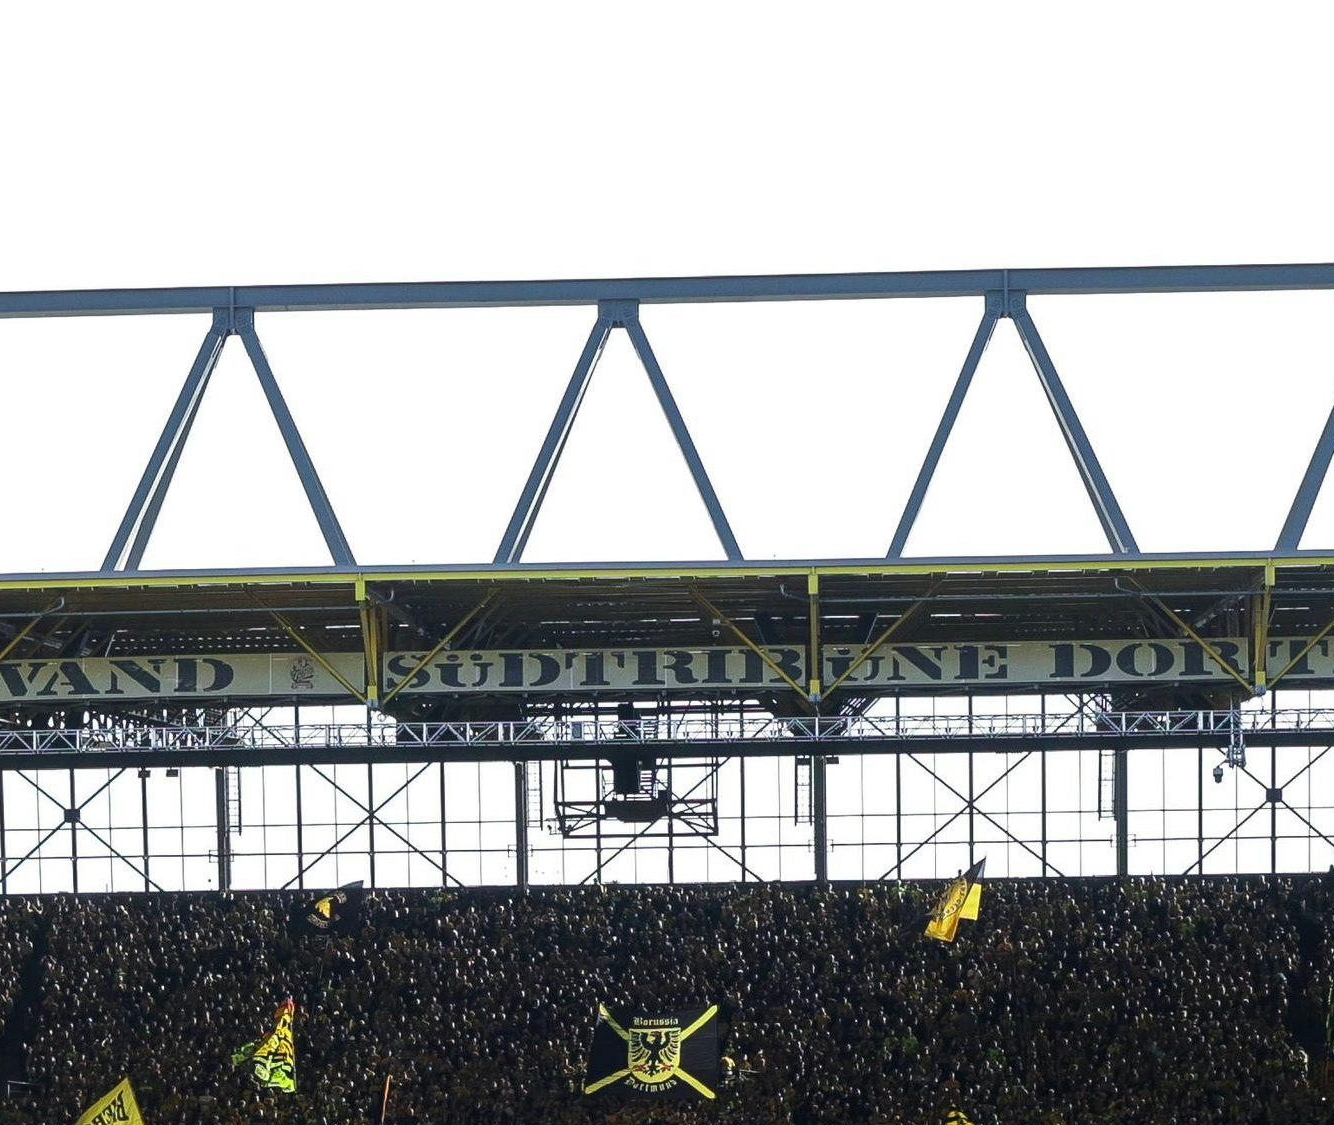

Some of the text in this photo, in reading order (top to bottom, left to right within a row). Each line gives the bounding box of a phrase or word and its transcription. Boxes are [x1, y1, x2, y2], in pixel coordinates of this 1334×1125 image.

[385, 645, 1010, 690] SÜDTRIBÜNE
[633, 1016, 679, 1027] Borussia
[624, 1075, 678, 1093] Dortmund
